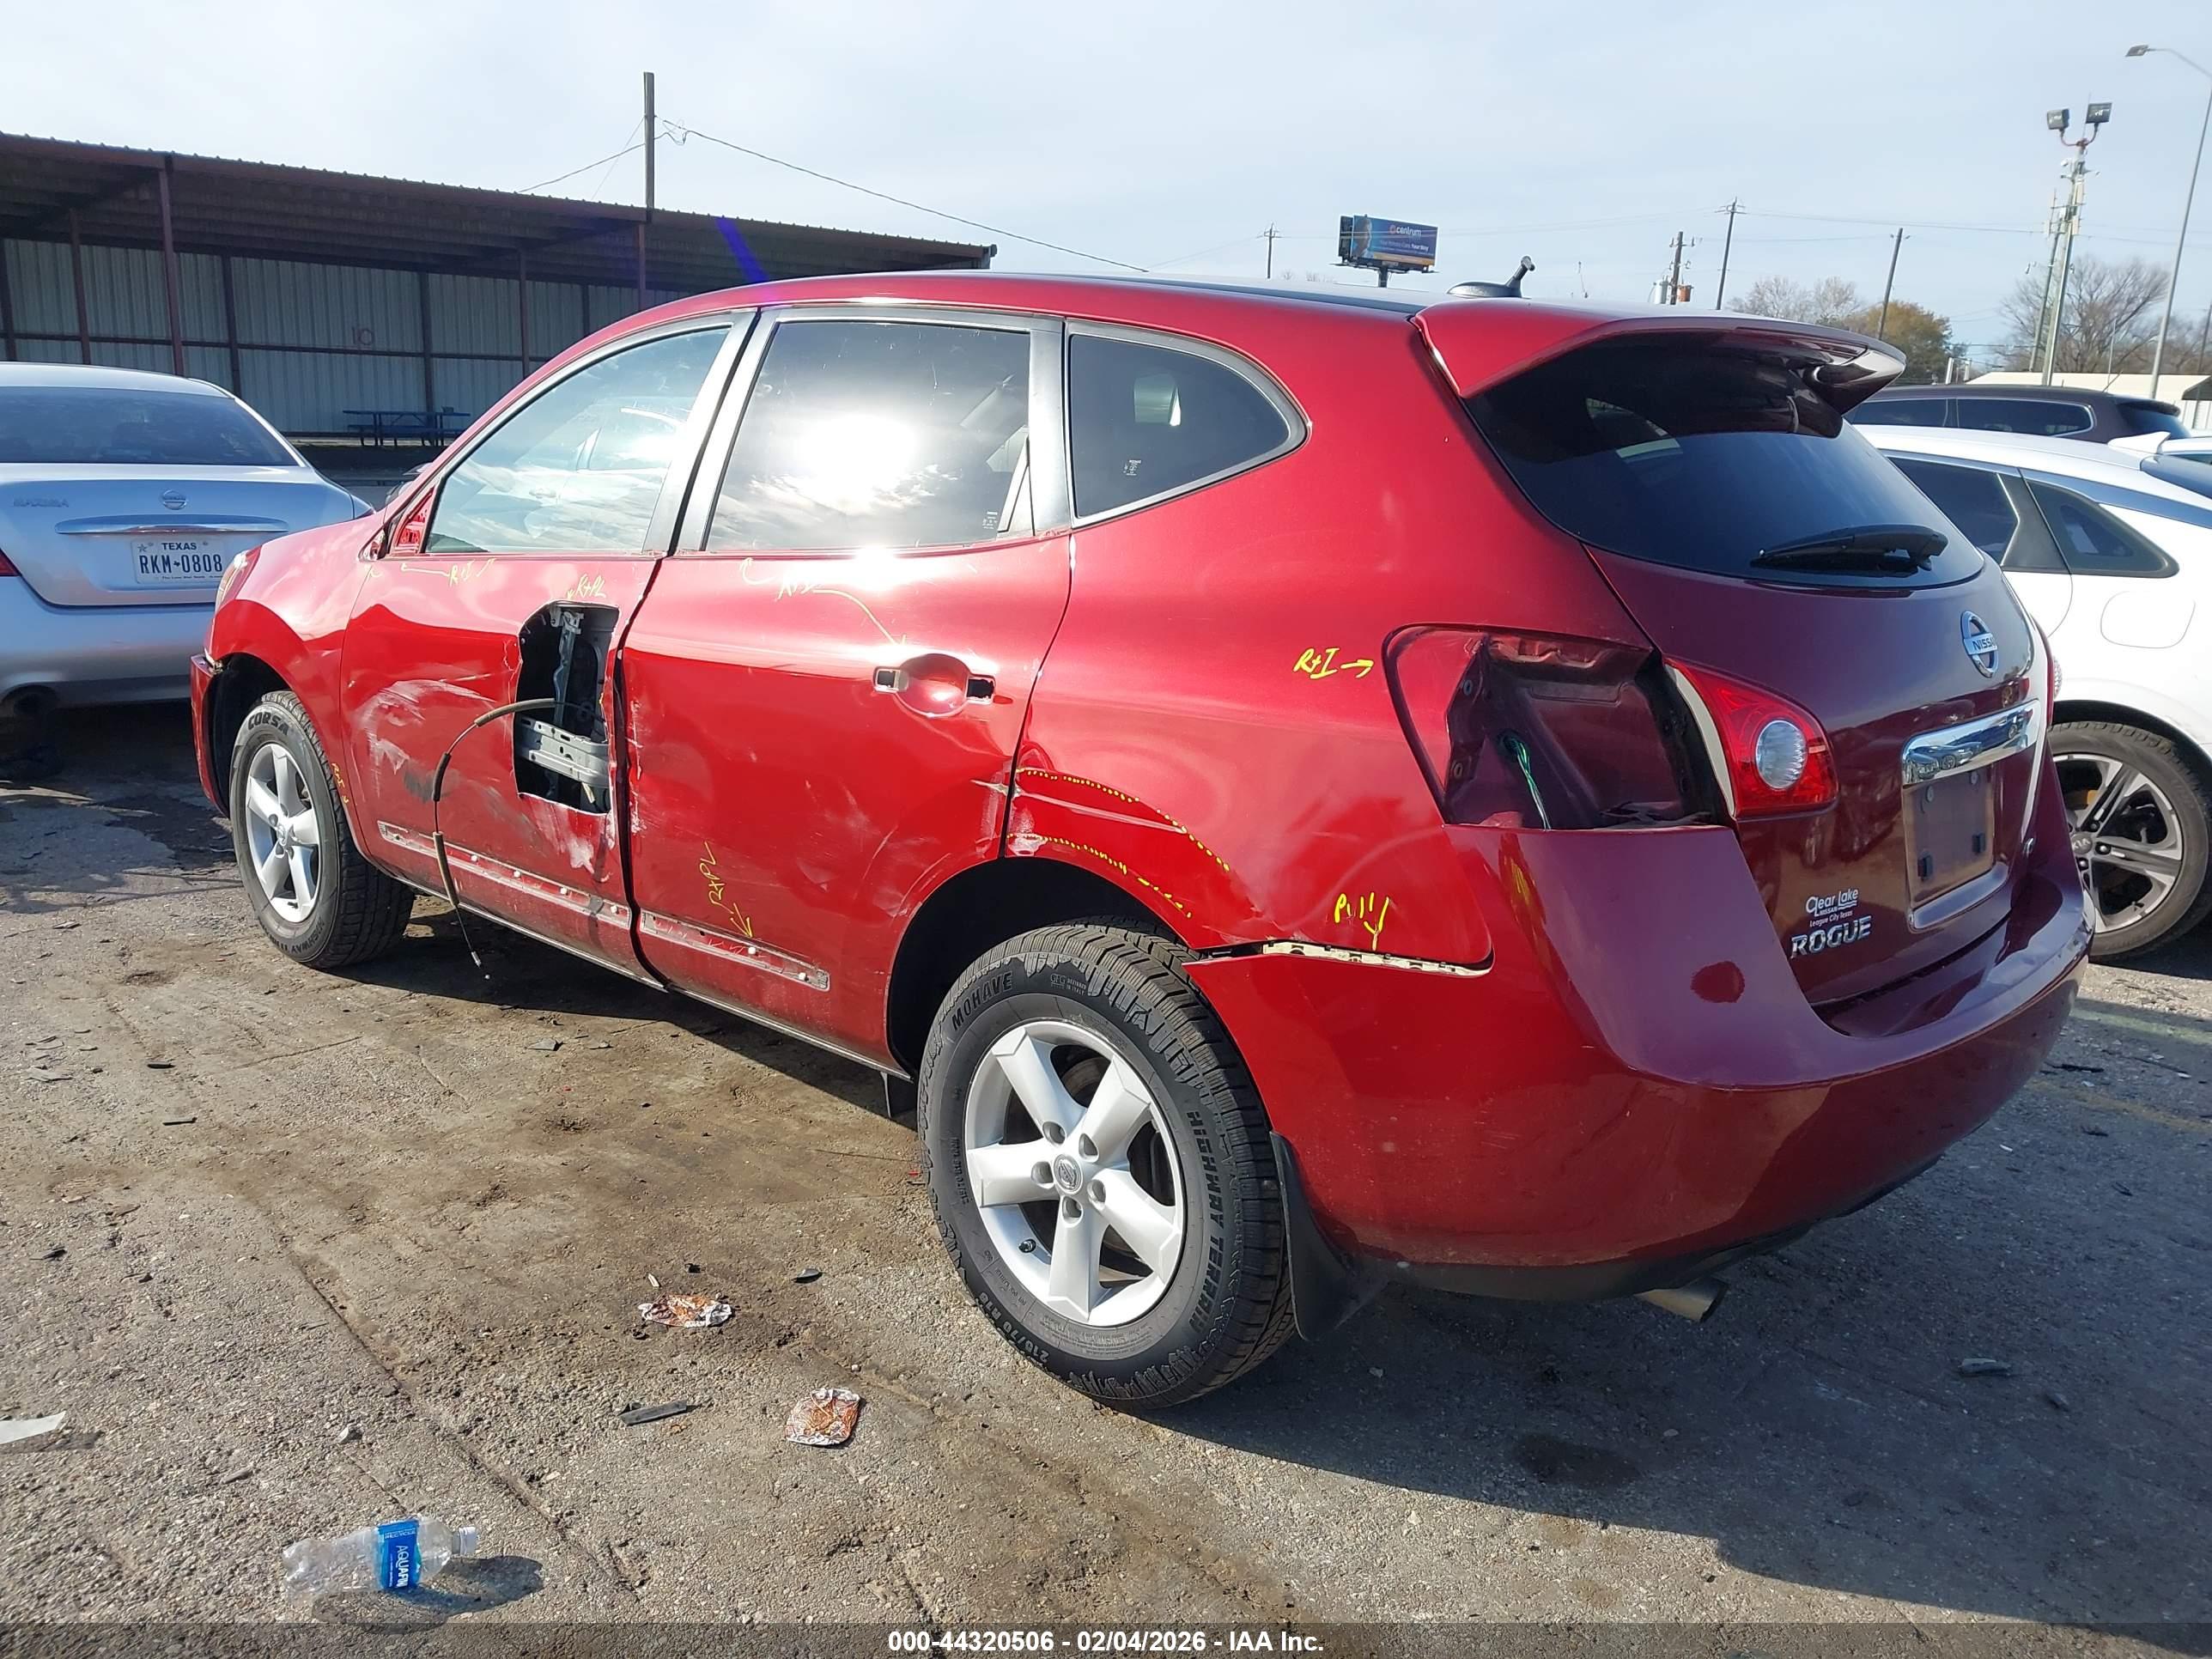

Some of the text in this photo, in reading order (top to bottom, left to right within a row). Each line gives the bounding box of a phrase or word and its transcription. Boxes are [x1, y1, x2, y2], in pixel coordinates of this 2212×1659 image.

[161, 542, 198, 551] TEXAS
[139, 554, 222, 574] RKM 0808
[247, 712, 289, 736] CORSA
[1806, 888, 1859, 917] Clear Lake
[1809, 917, 1829, 927] League
[1829, 913, 1839, 921] City
[1790, 915, 1872, 959] ROGUE
[951, 971, 1013, 1031] MOHAVE
[1187, 1111, 1224, 1333] HIGHWAY TERRAIN
